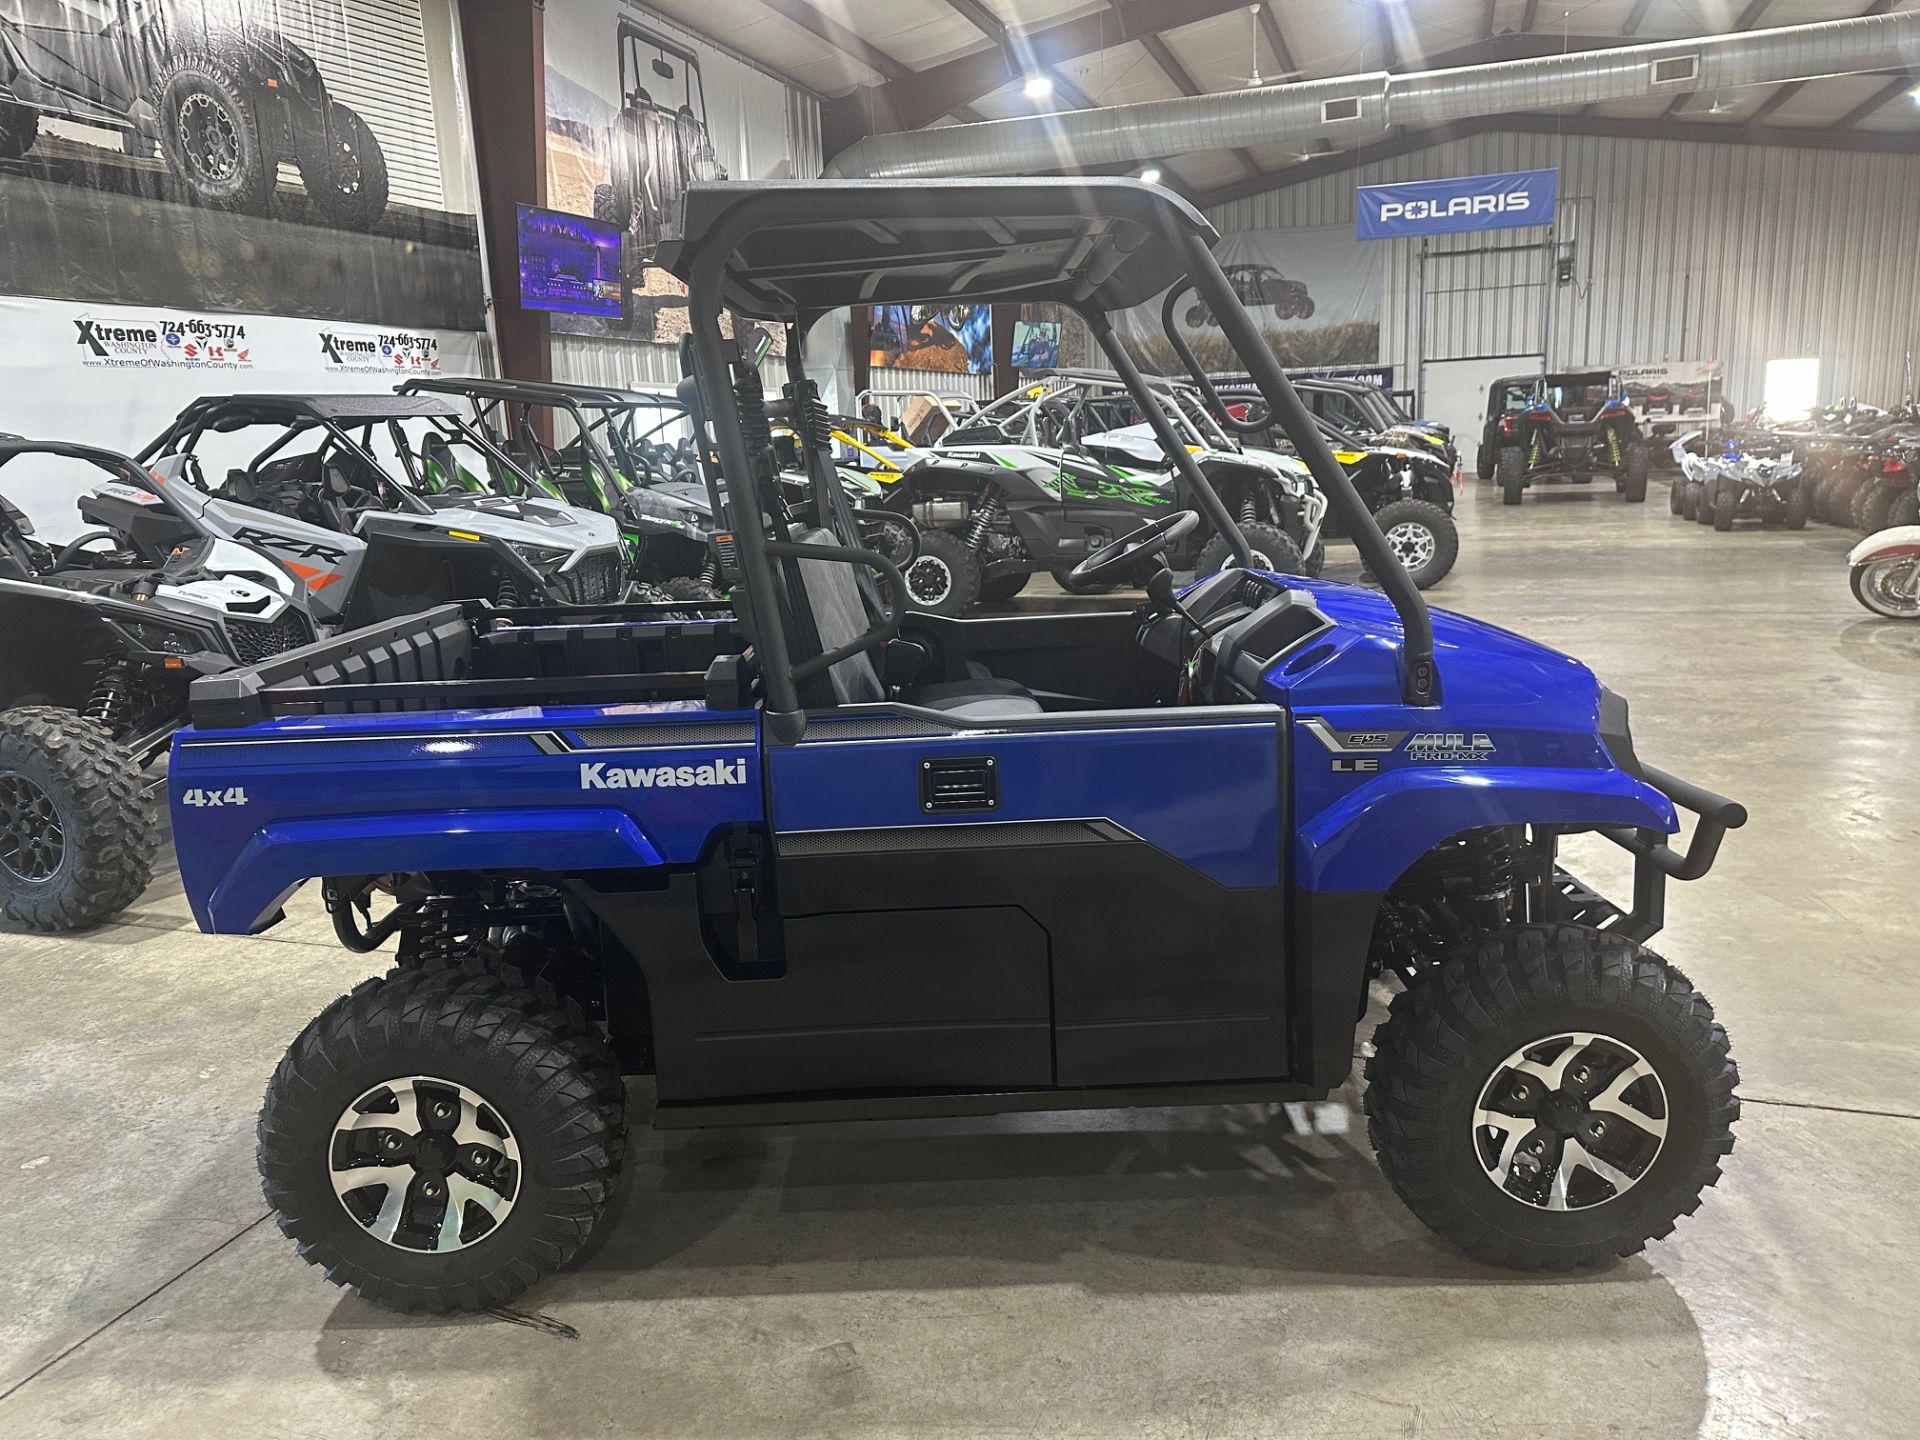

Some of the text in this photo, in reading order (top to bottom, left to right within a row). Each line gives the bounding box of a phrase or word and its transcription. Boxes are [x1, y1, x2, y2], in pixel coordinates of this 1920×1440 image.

[1380, 191, 1530, 222] POLARIS
[73, 320, 157, 356] Xtreme
[160, 319, 246, 339] 724-663-5774
[319, 333, 376, 363] Xtreme
[378, 333, 437, 350] 724-663-5774
[82, 358, 253, 370] www.XtremeOfWashingtonCounty.com
[1618, 368, 1668, 376] POLARIS
[947, 451, 980, 459] Kawasaki
[232, 526, 348, 566] RZR
[1403, 733, 1496, 751] MULE
[580, 758, 746, 790] Kawasaki
[1331, 759, 1379, 772] LE
[182, 786, 248, 807] 4x4
